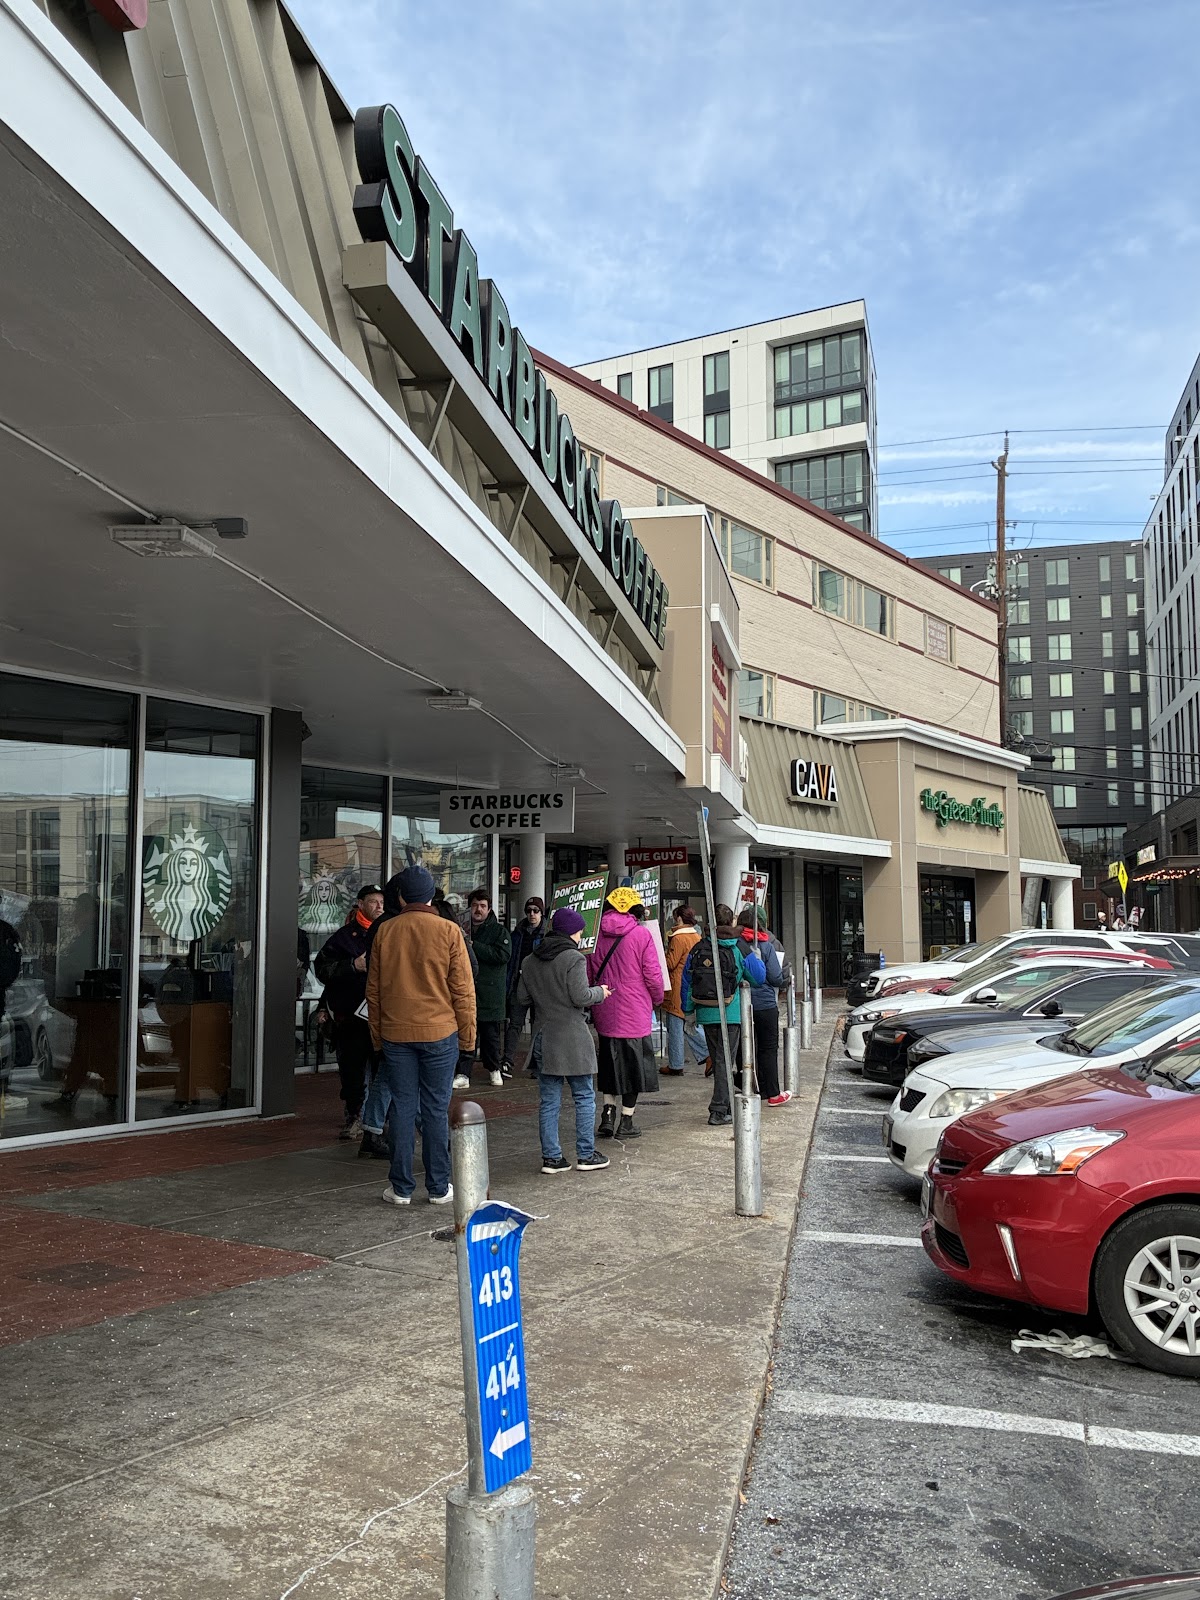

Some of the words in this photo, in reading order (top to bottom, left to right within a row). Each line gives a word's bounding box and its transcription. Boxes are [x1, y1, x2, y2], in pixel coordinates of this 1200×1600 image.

[356, 103, 604, 553] STARBUCKS
[603, 499, 669, 650] COFFEE
[795, 758, 839, 802] CAVA
[449, 793, 564, 810] STARBUCKS
[922, 786, 939, 811] the
[936, 790, 977, 828] Greene
[974, 797, 1005, 829] Turtle
[469, 813, 541, 828] COFFEE
[625, 853, 650, 862] FIVE
[653, 851, 684, 861] GUYS
[554, 884, 577, 899] DON'T
[578, 878, 604, 891] CROSS
[676, 881, 691, 890] 7350
[569, 892, 584, 903] OUR
[581, 898, 601, 911] LINE
[641, 895, 659, 907] RIKE!
[478, 1265, 513, 1308] 413
[485, 1354, 521, 1401] 414
